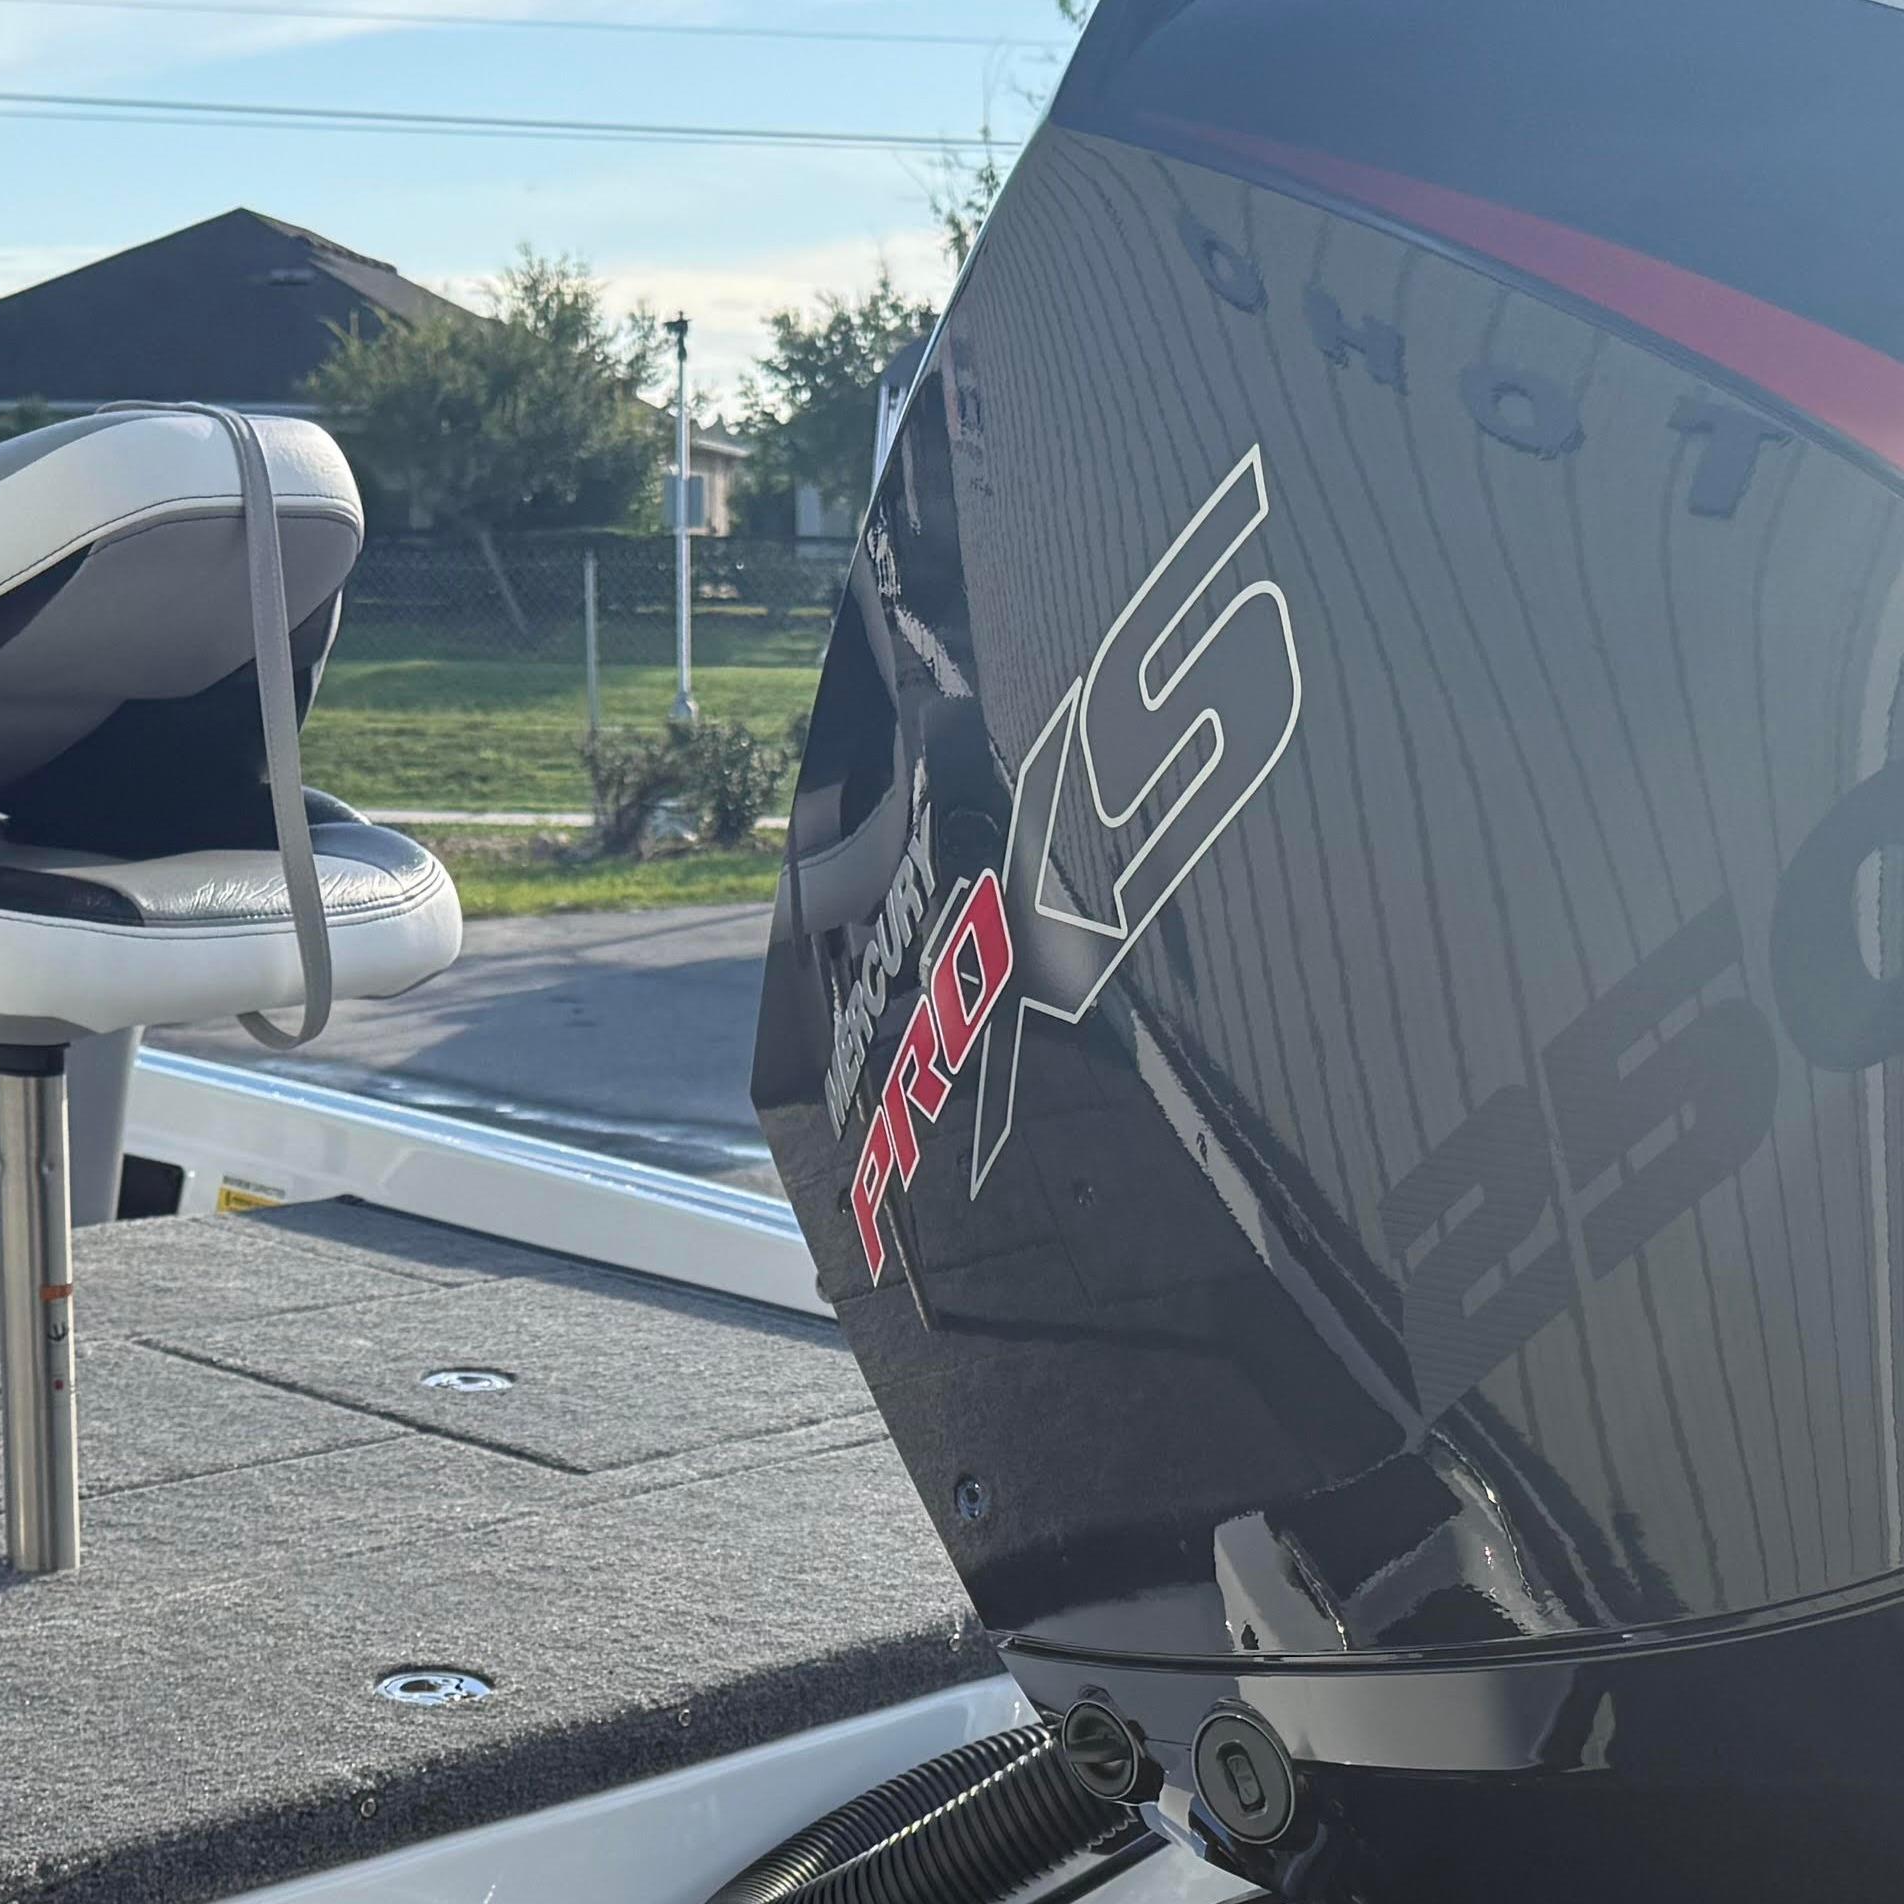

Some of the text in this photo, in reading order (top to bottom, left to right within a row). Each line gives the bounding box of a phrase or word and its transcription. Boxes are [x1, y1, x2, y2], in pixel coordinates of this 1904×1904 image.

[825, 802, 937, 1142] MERCURY
[850, 443, 1303, 1288] PRO XS
